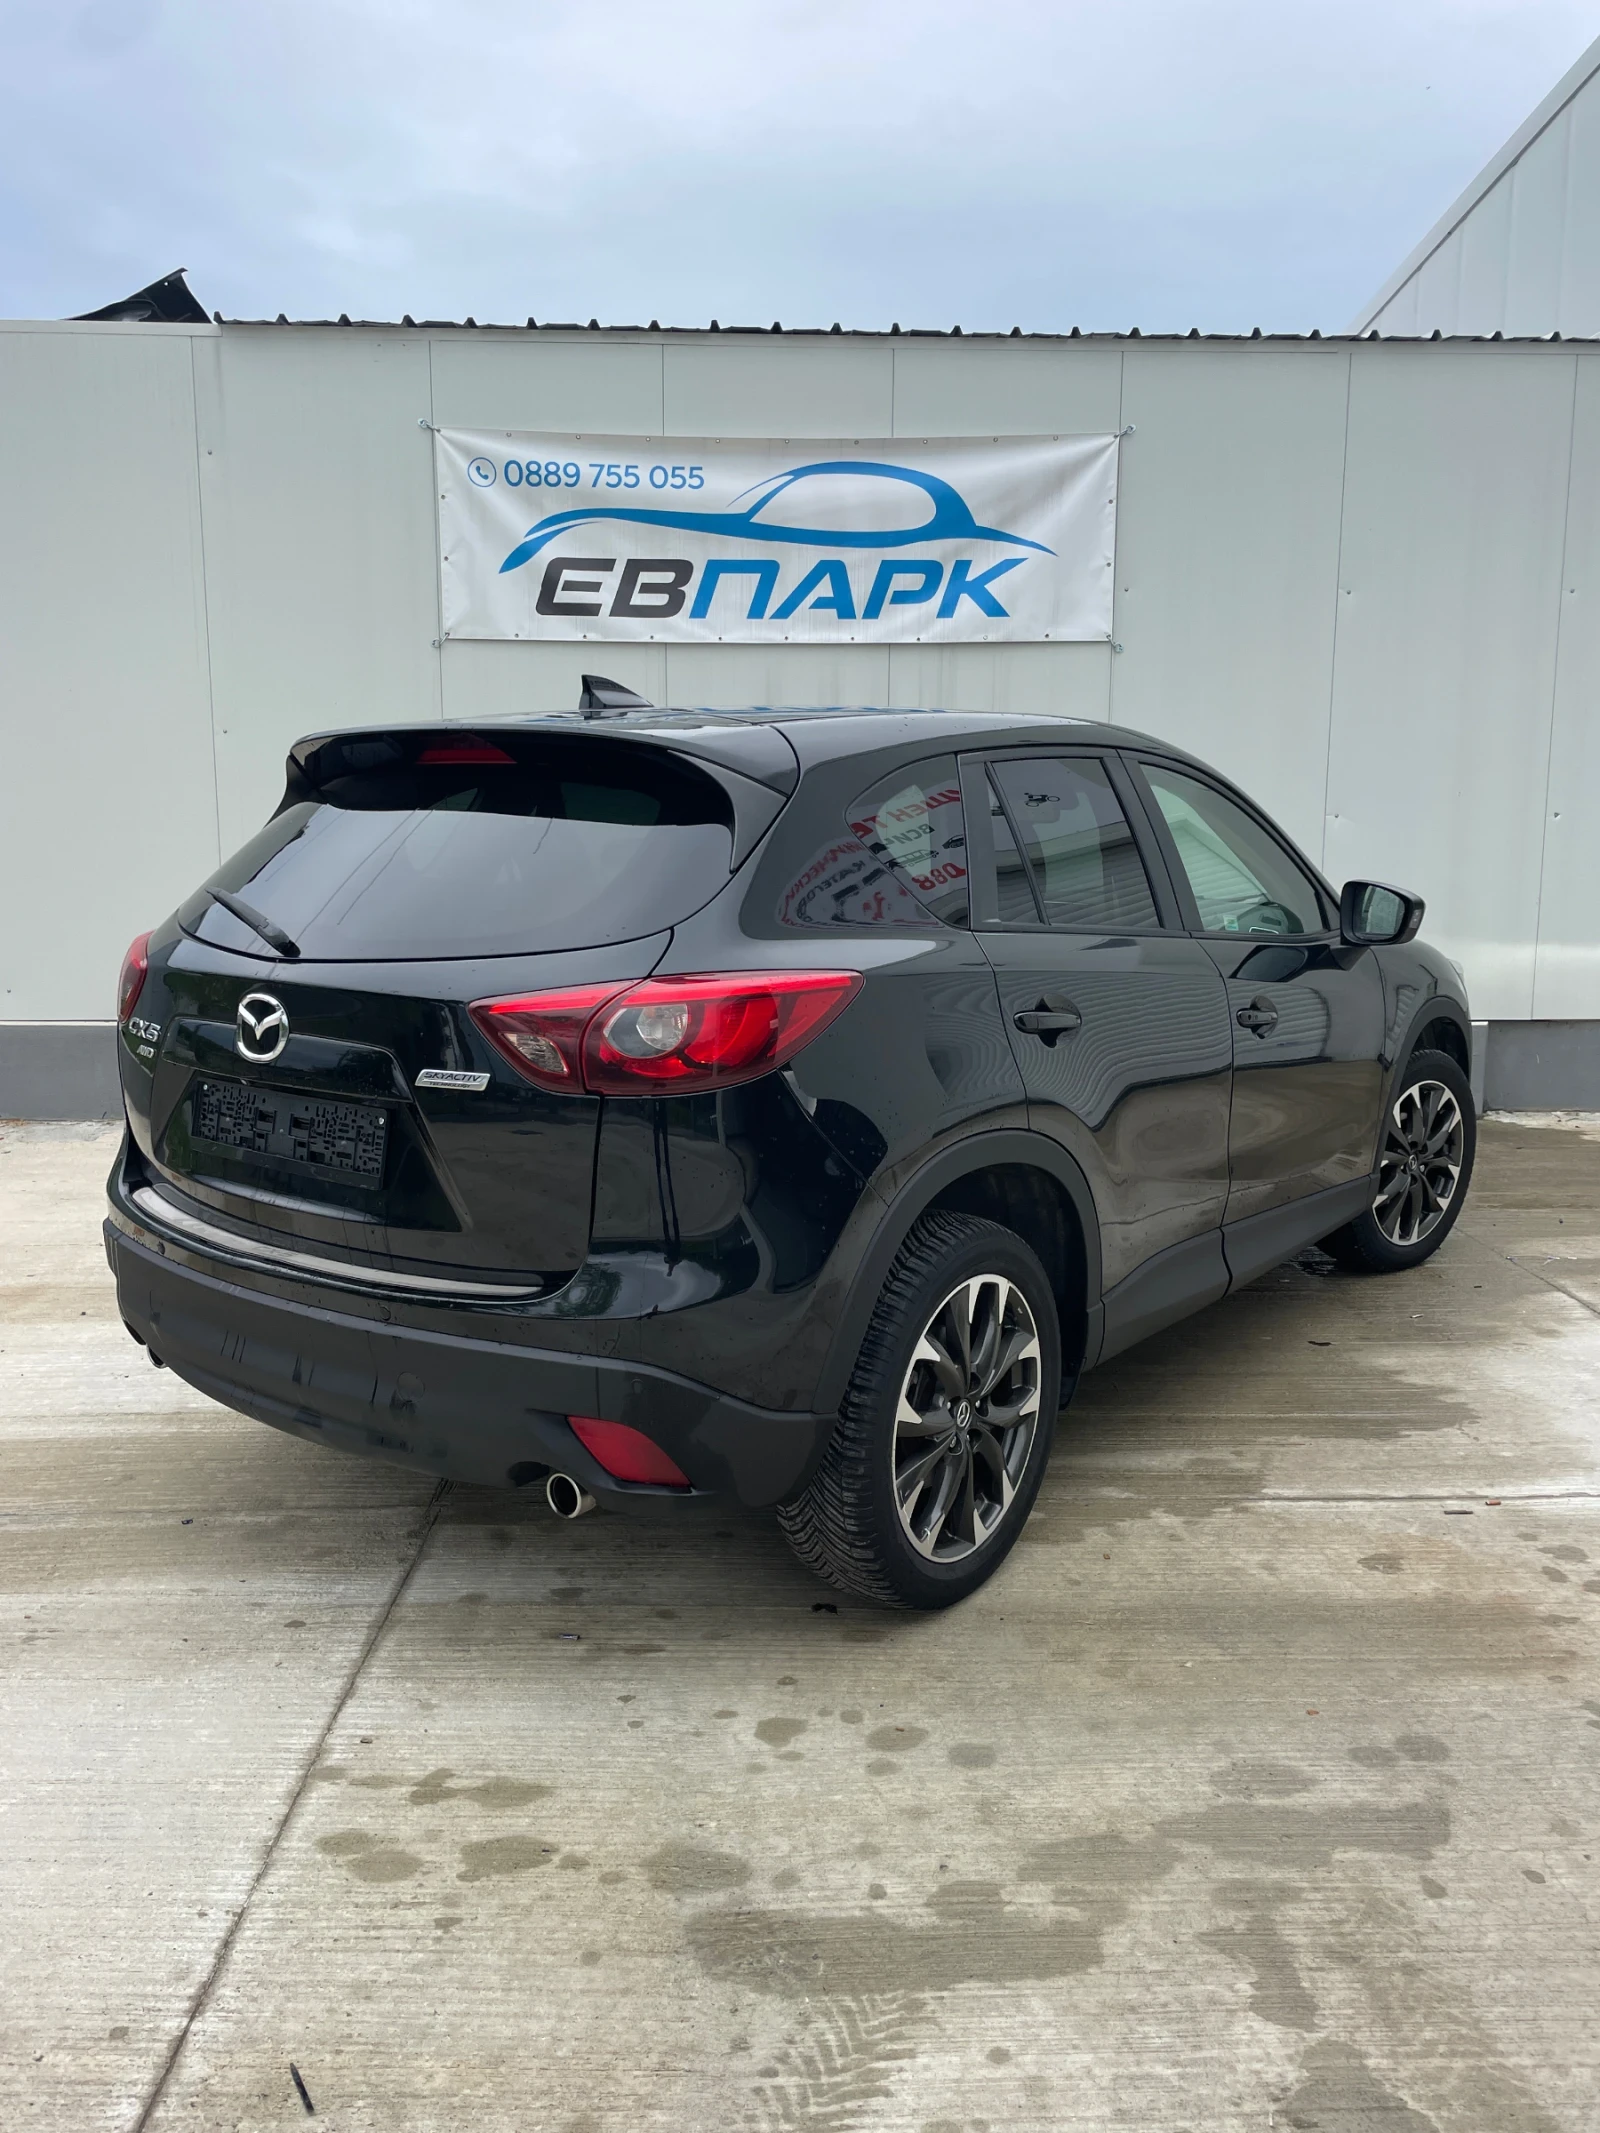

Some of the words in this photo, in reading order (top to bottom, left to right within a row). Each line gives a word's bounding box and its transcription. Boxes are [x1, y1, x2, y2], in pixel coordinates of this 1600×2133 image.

[503, 459, 581, 488] 0889
[588, 463, 641, 489] 755
[649, 465, 705, 490] 055
[535, 556, 1029, 620] ЕВПАРК
[136, 1044, 155, 1059] AWD
[423, 1071, 482, 1082] SKYACTIV
[429, 1081, 471, 1089] TECHNOLOGY
